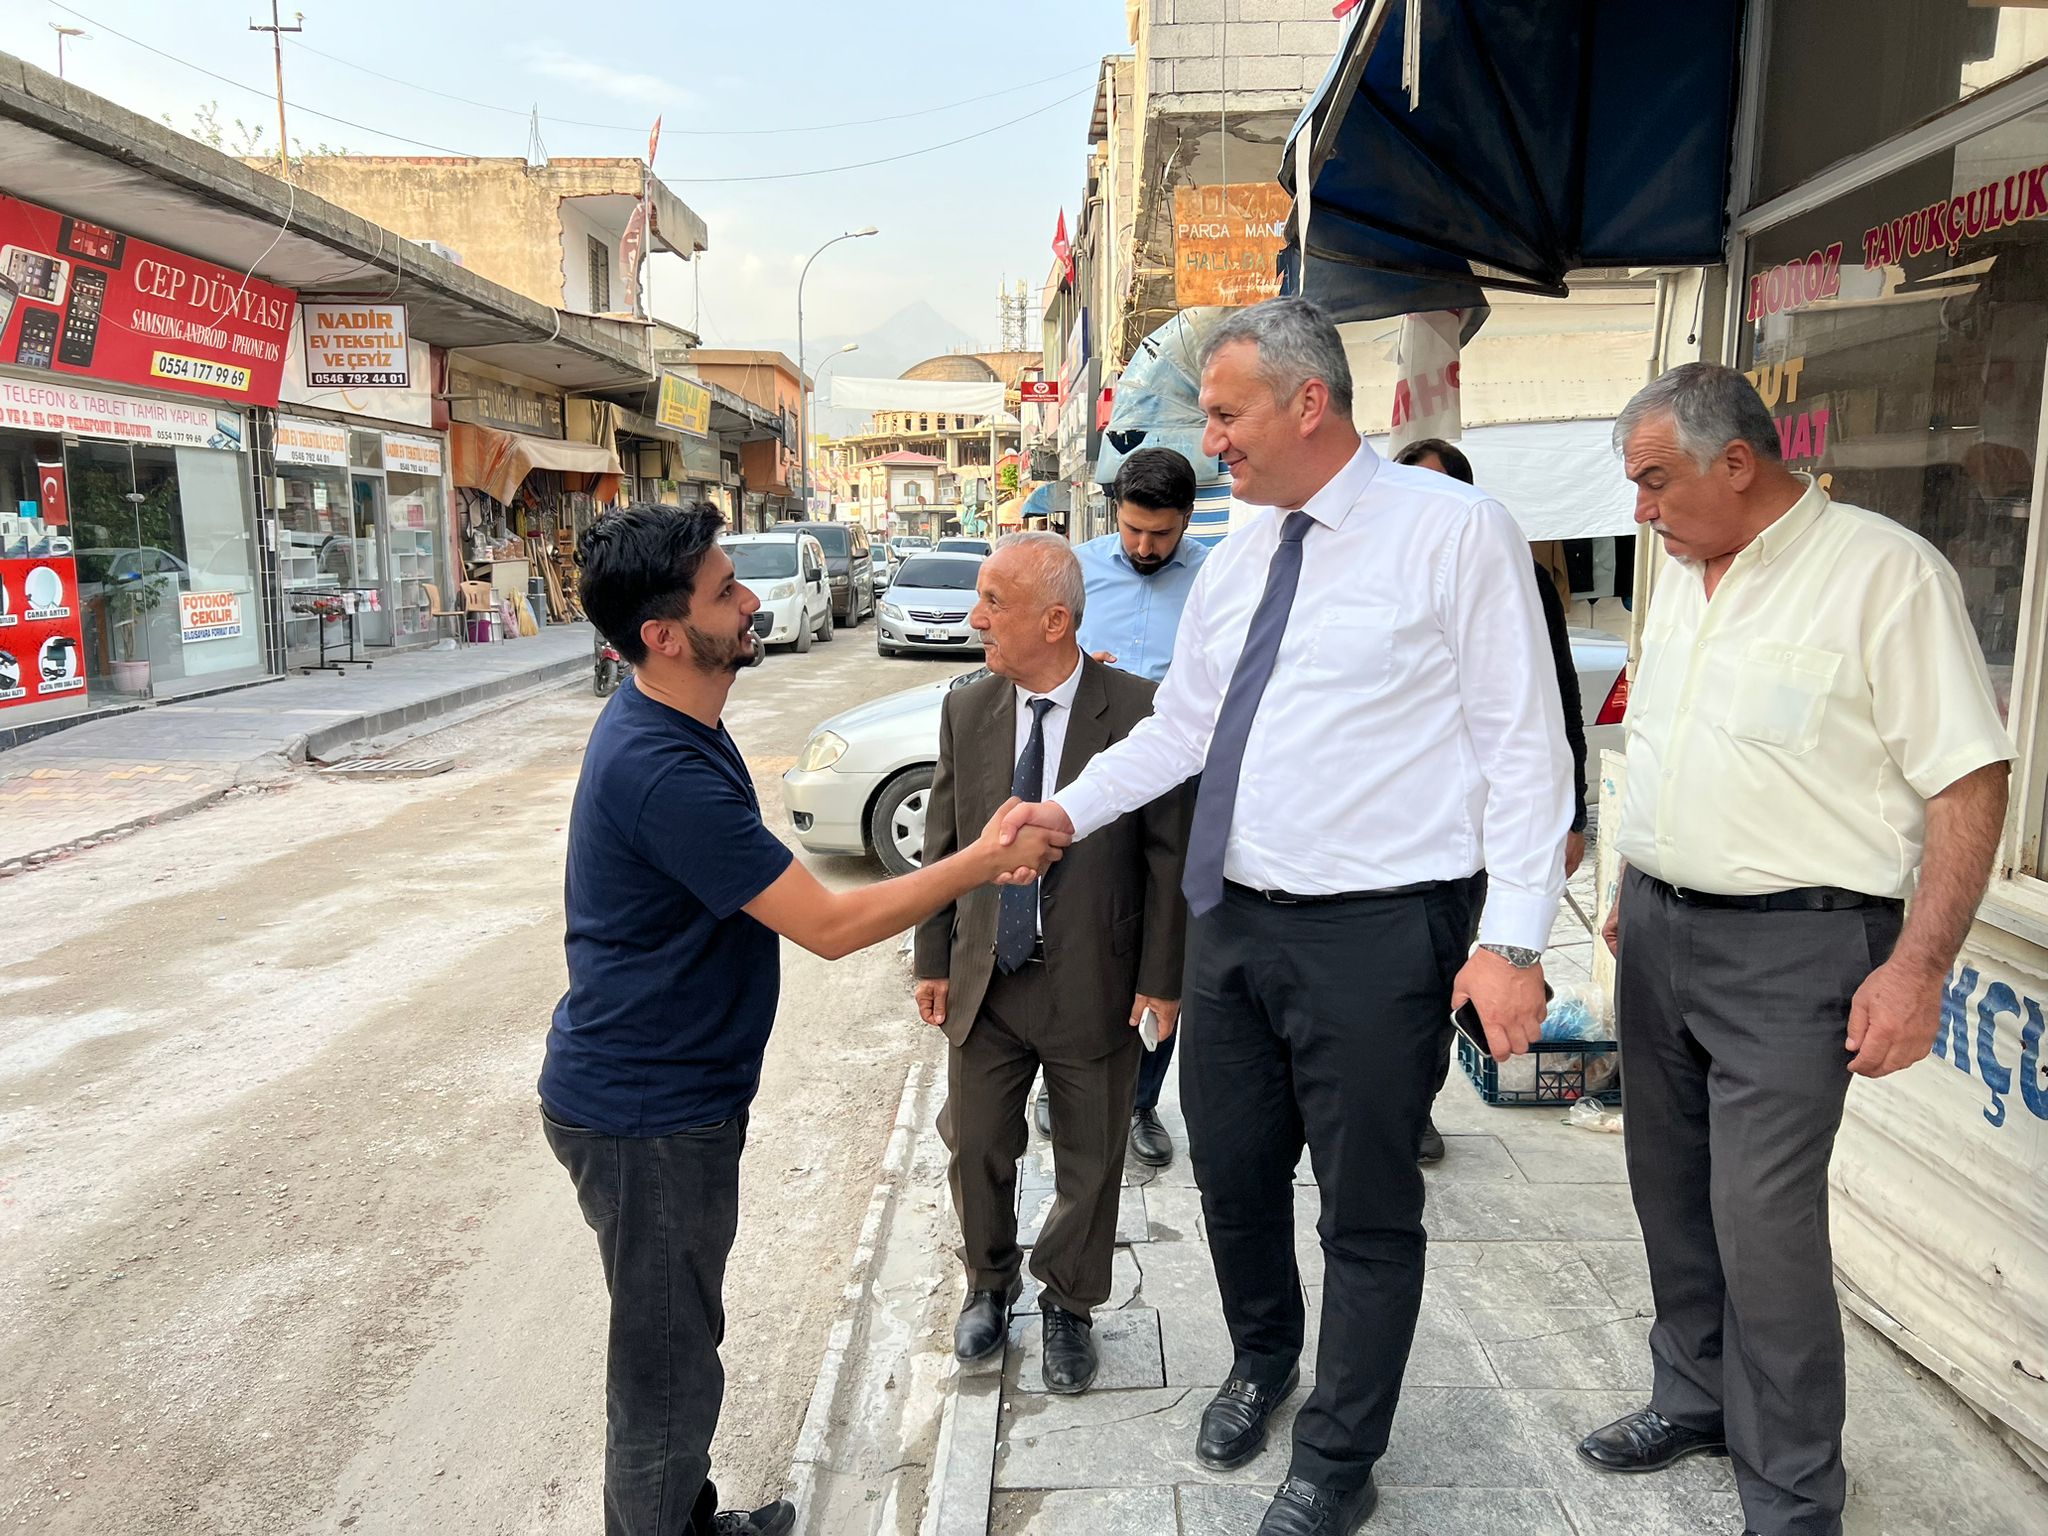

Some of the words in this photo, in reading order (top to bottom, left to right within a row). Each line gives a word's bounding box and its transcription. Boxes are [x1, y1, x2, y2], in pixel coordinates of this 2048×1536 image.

[1178, 223, 1230, 240] PARÇA
[1746, 241, 1843, 322] HOROZ
[134, 258, 186, 301] CEP
[188, 273, 289, 331] DÜNYASI
[317, 309, 393, 329] NADİR
[131, 308, 184, 340] SAMSUNG
[183, 322, 228, 350] ANDROID
[232, 333, 266, 359] IPHONE
[264, 340, 281, 362] IOS
[310, 335, 331, 348] EV
[333, 331, 404, 348] TEKSTİLİ
[323, 353, 344, 366] VE
[347, 350, 392, 370] ÇEYİZ
[159, 356, 189, 378] 0554
[193, 362, 213, 380] 177
[215, 366, 230, 384] 99
[231, 370, 245, 386] 69
[315, 374, 344, 384] 0546
[347, 374, 369, 384] 792
[372, 374, 387, 384] 44
[389, 374, 404, 384] 01
[3, 384, 66, 410] TELEFON
[69, 396, 79, 410] &
[83, 395, 127, 417] TABLET
[131, 402, 168, 422] TAMİRİ
[170, 409, 209, 427] YAPILIR
[6, 408, 20, 423] VE
[33, 412, 45, 426] EL
[67, 416, 112, 434] TELEFONU
[113, 421, 153, 438] BULUNUR
[157, 430, 172, 441] 0554
[173, 432, 185, 442] 177
[185, 434, 194, 443] 99
[194, 435, 202, 444] 69
[291, 451, 305, 461] 0546
